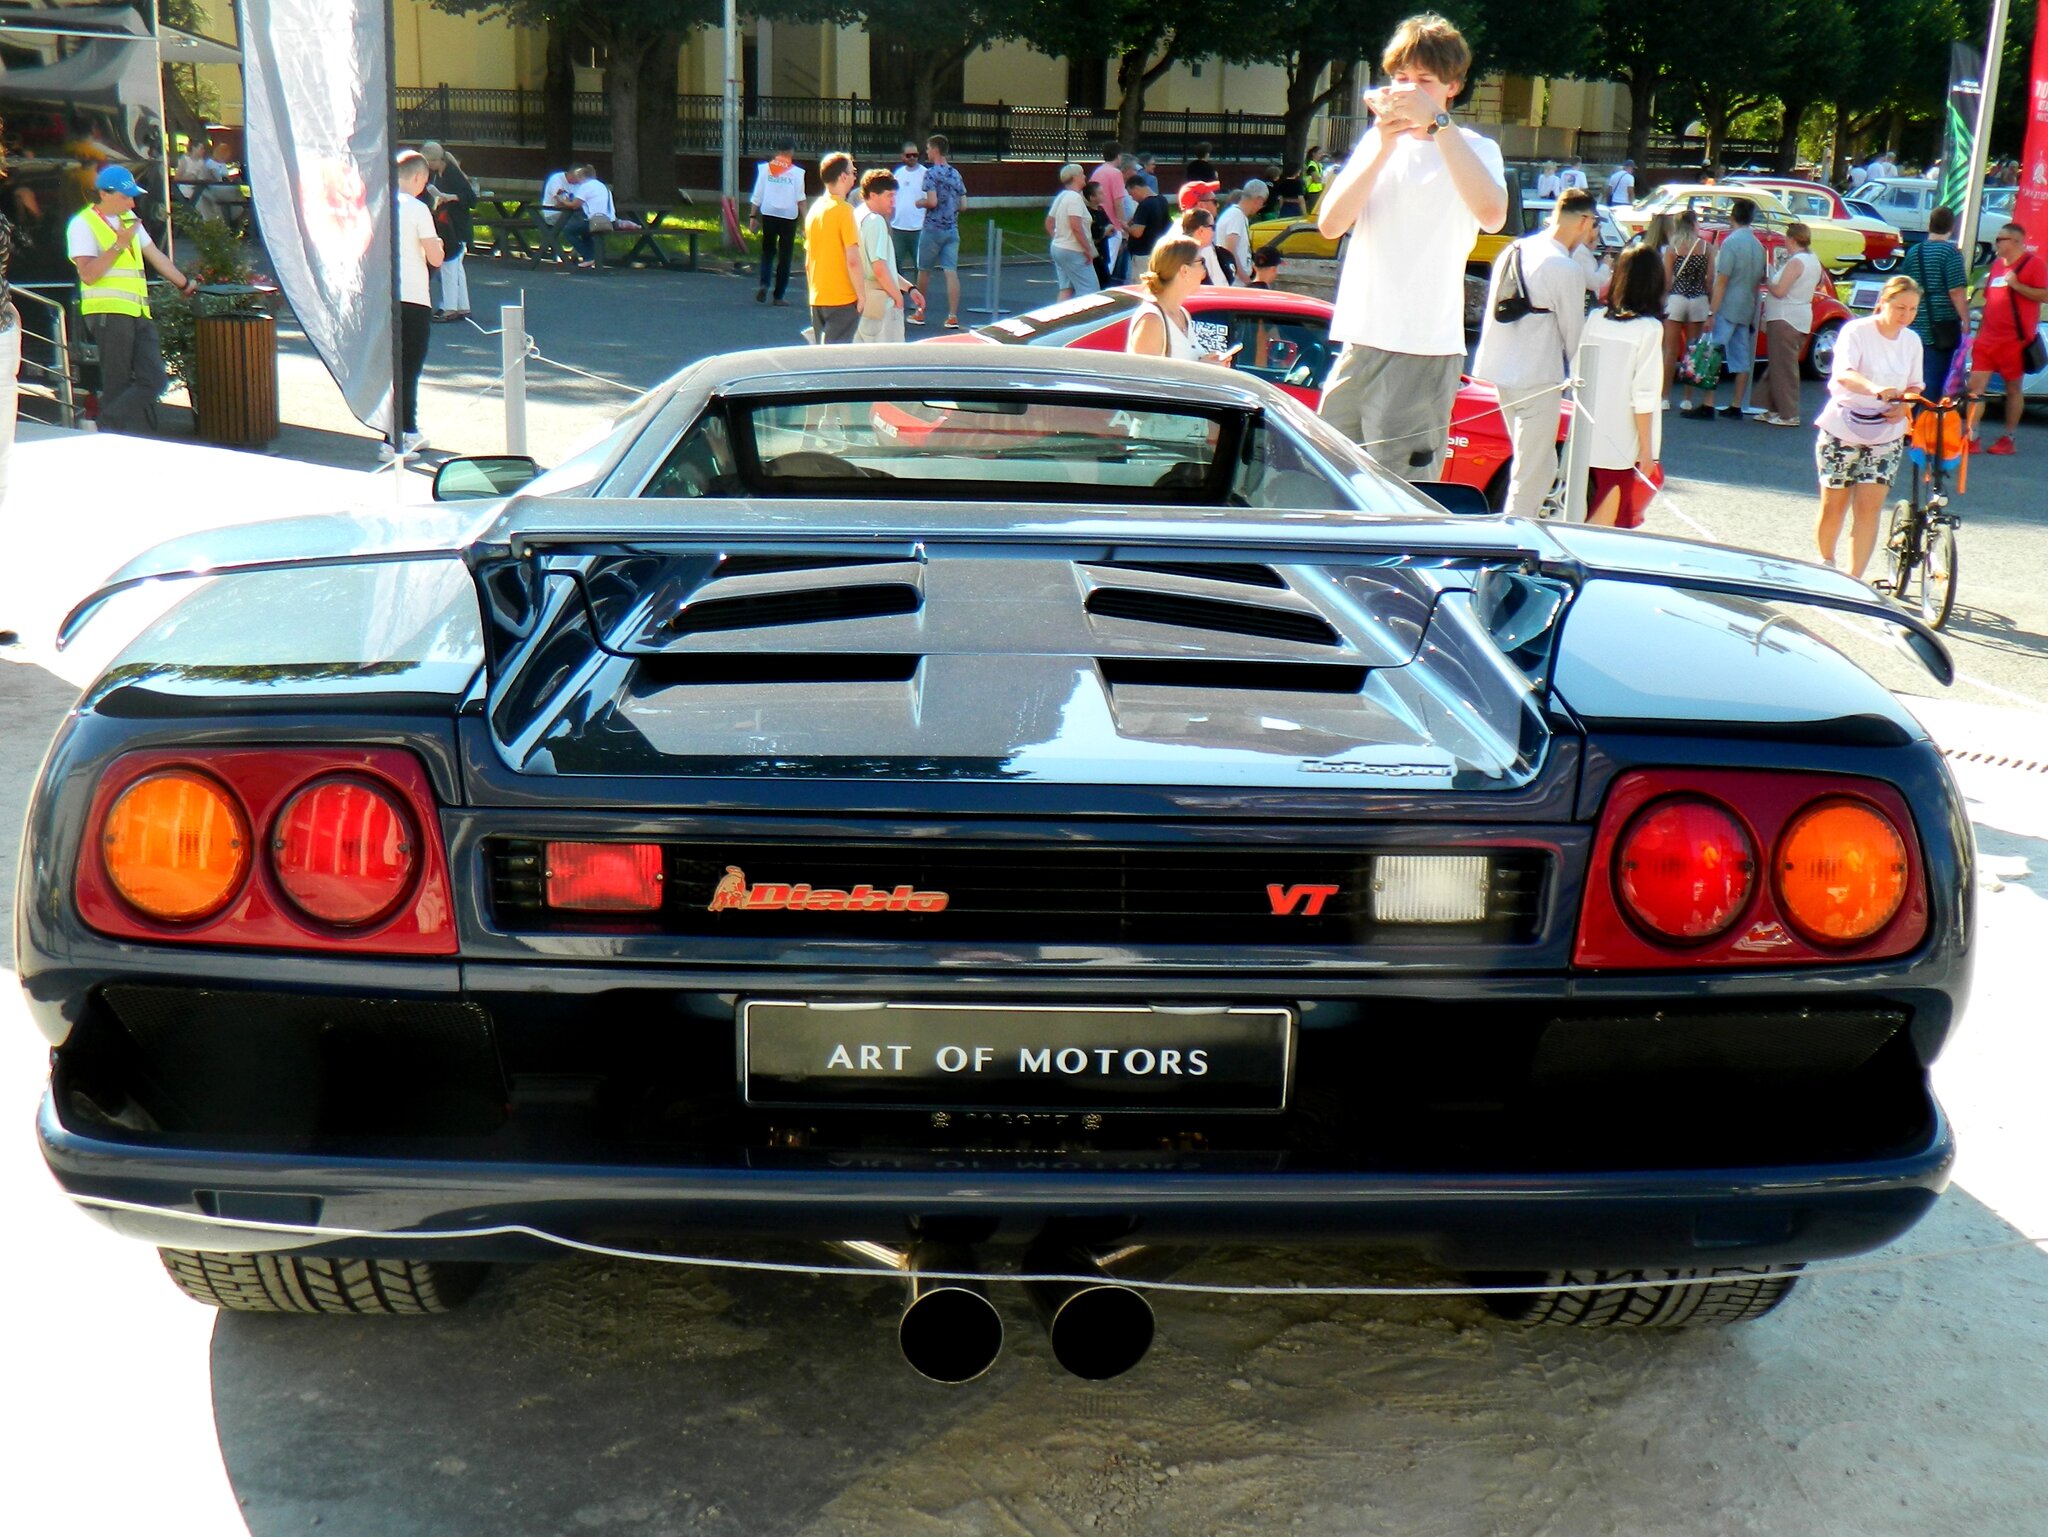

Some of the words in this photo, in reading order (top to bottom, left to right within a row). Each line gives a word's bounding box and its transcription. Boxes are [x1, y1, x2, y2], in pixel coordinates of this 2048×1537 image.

[746, 884, 950, 912] Diablo
[1266, 883, 1340, 916] VT
[827, 1044, 911, 1071] ART
[936, 1046, 995, 1073] OF
[1020, 1048, 1209, 1075] MOTORS
